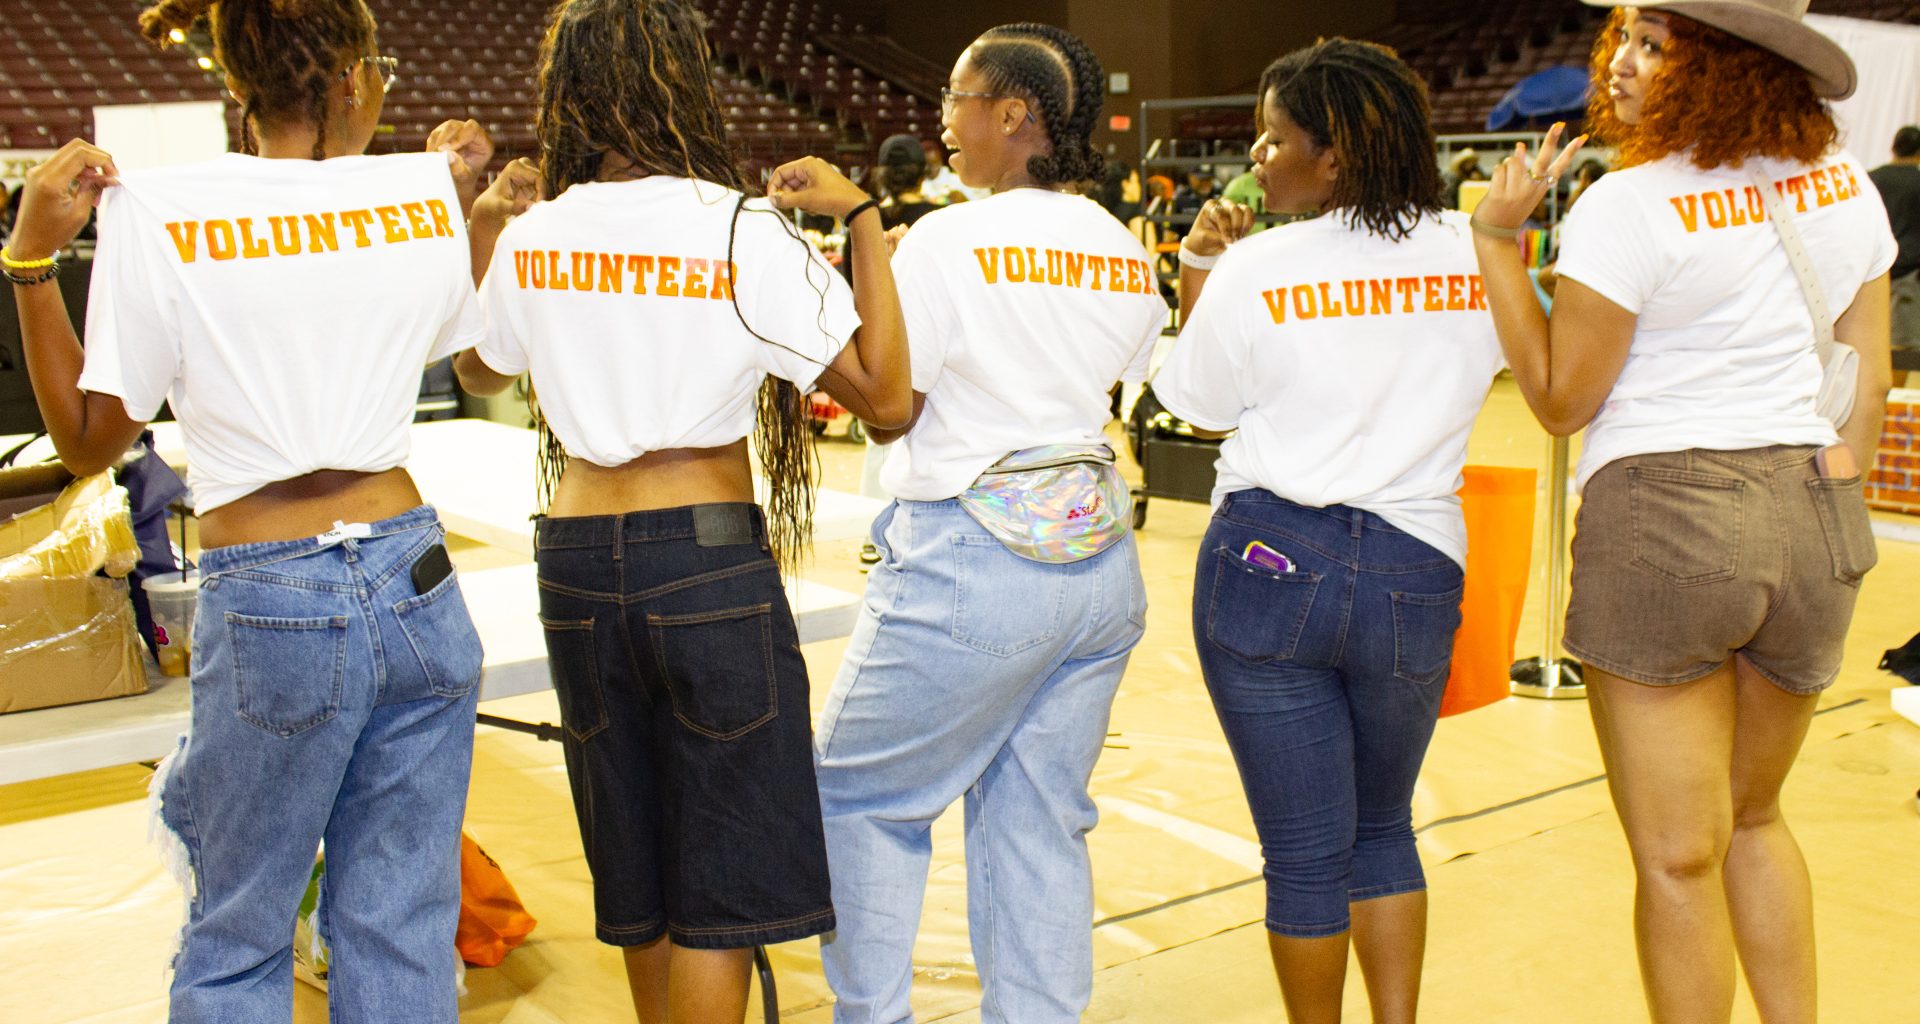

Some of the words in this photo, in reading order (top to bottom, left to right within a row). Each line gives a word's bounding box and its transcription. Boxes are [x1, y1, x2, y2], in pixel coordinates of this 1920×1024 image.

[1669, 163, 1862, 233] VOLUTEER
[165, 199, 454, 263] VOLUNTEER
[514, 250, 738, 301] VOLUNTEER
[974, 246, 1157, 296] VOLUNTEER
[1262, 274, 1487, 325] VOLUNTEER
